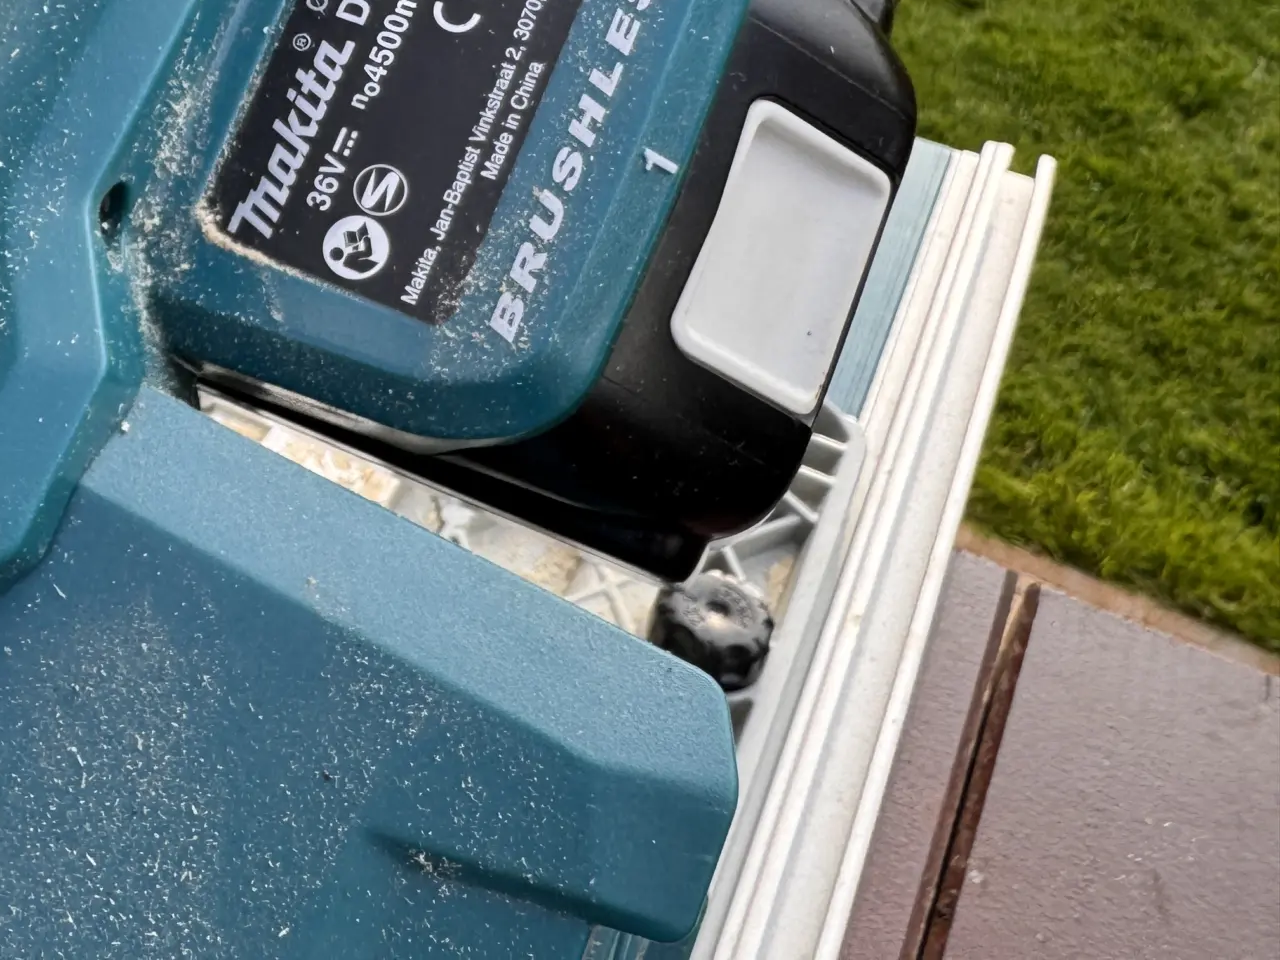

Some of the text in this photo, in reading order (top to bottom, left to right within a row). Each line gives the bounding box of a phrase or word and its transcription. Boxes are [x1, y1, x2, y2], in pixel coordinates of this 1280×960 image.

[400, 245, 442, 306] Makita,
[430, 145, 481, 242] Jan-Baptist
[469, 59, 517, 141] Vinkstraat
[505, 43, 527, 60] 2,
[480, 61, 544, 181] Made in China
[643, 147, 679, 175] 1
